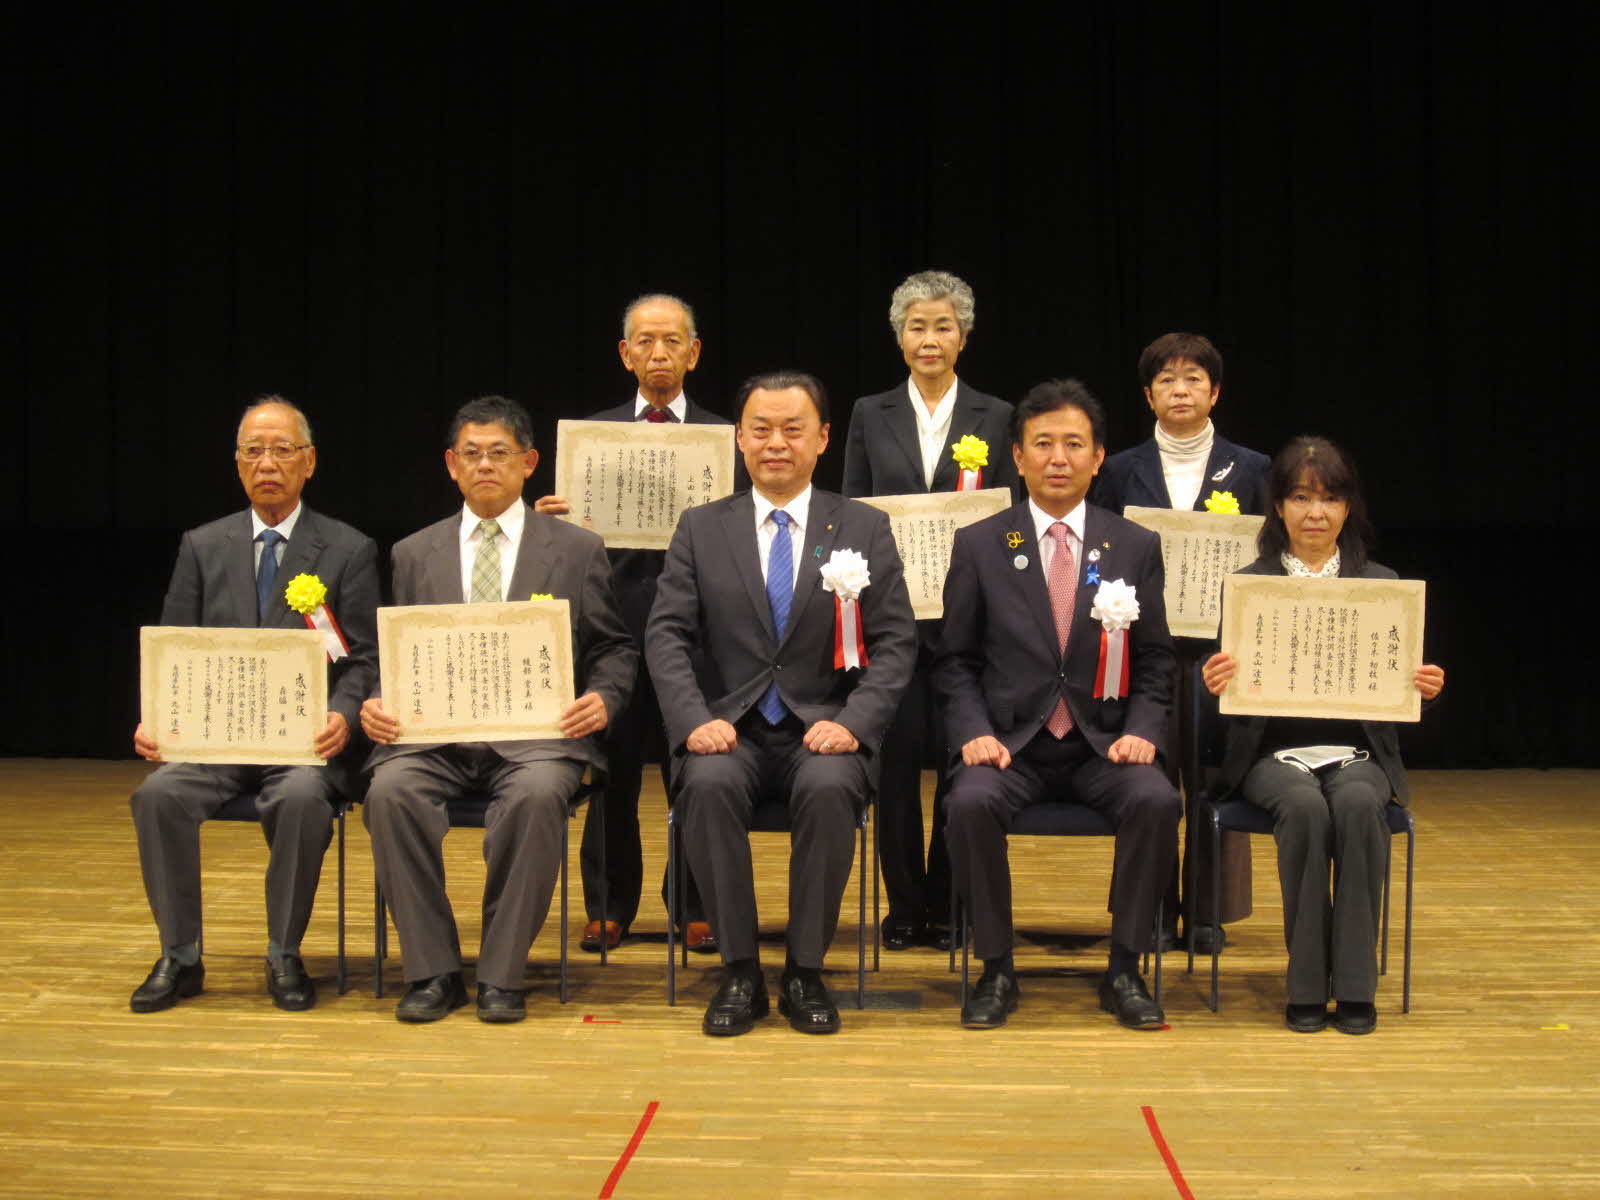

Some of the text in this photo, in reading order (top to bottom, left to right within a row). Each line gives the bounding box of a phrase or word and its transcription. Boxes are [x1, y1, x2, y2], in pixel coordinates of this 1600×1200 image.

[703, 465, 713, 503] 感謝状
[539, 645, 552, 689] 感謝状
[1387, 625, 1400, 671] 感謝状
